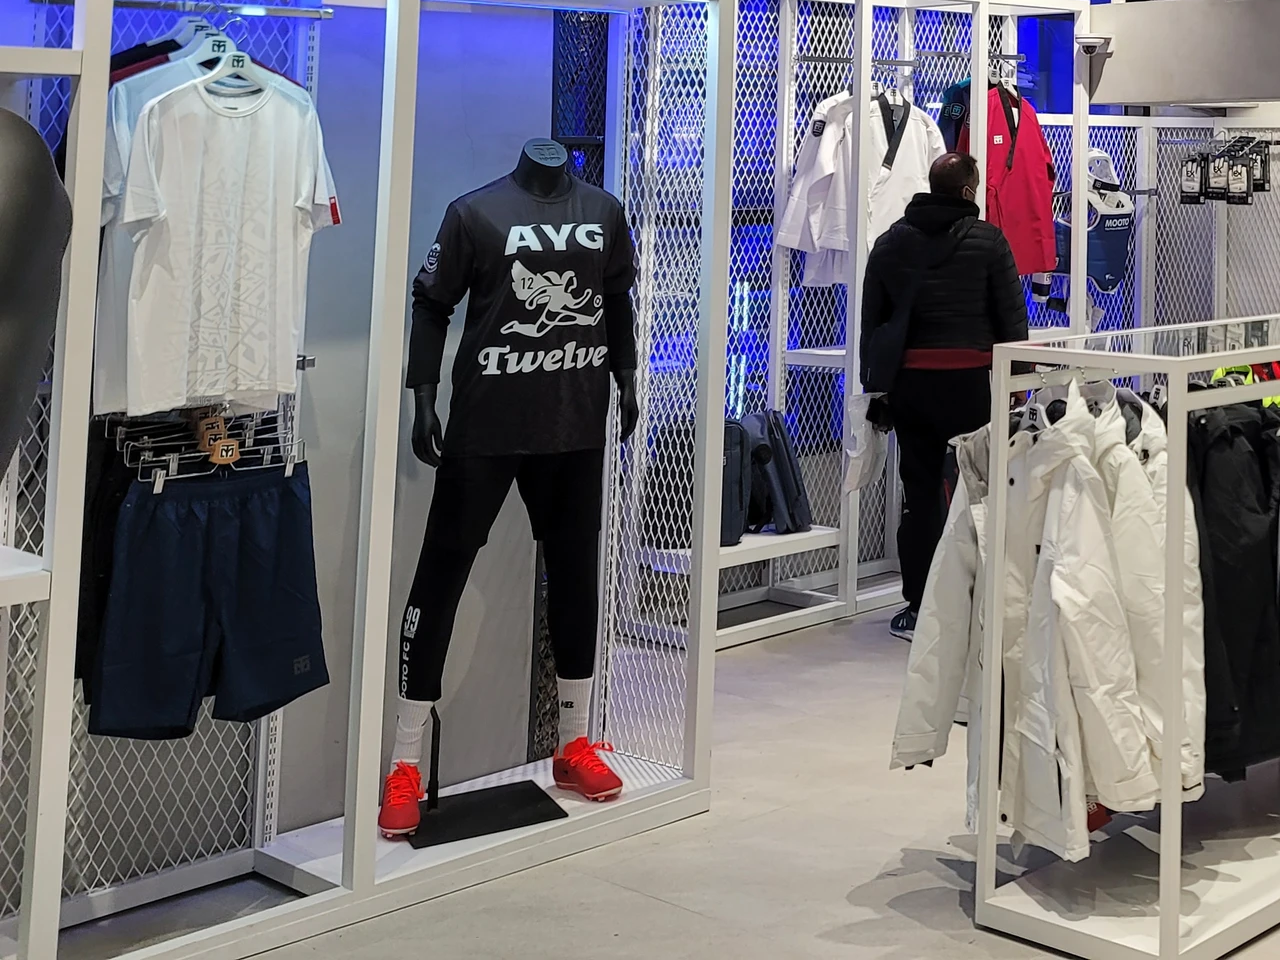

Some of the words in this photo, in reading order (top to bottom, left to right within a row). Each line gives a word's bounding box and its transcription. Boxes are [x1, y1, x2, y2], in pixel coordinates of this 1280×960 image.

[1105, 217, 1130, 228] MOOTO
[504, 223, 604, 256] AYG
[520, 276, 534, 291] 12
[477, 341, 609, 376] Twelve
[402, 641, 411, 661] FC
